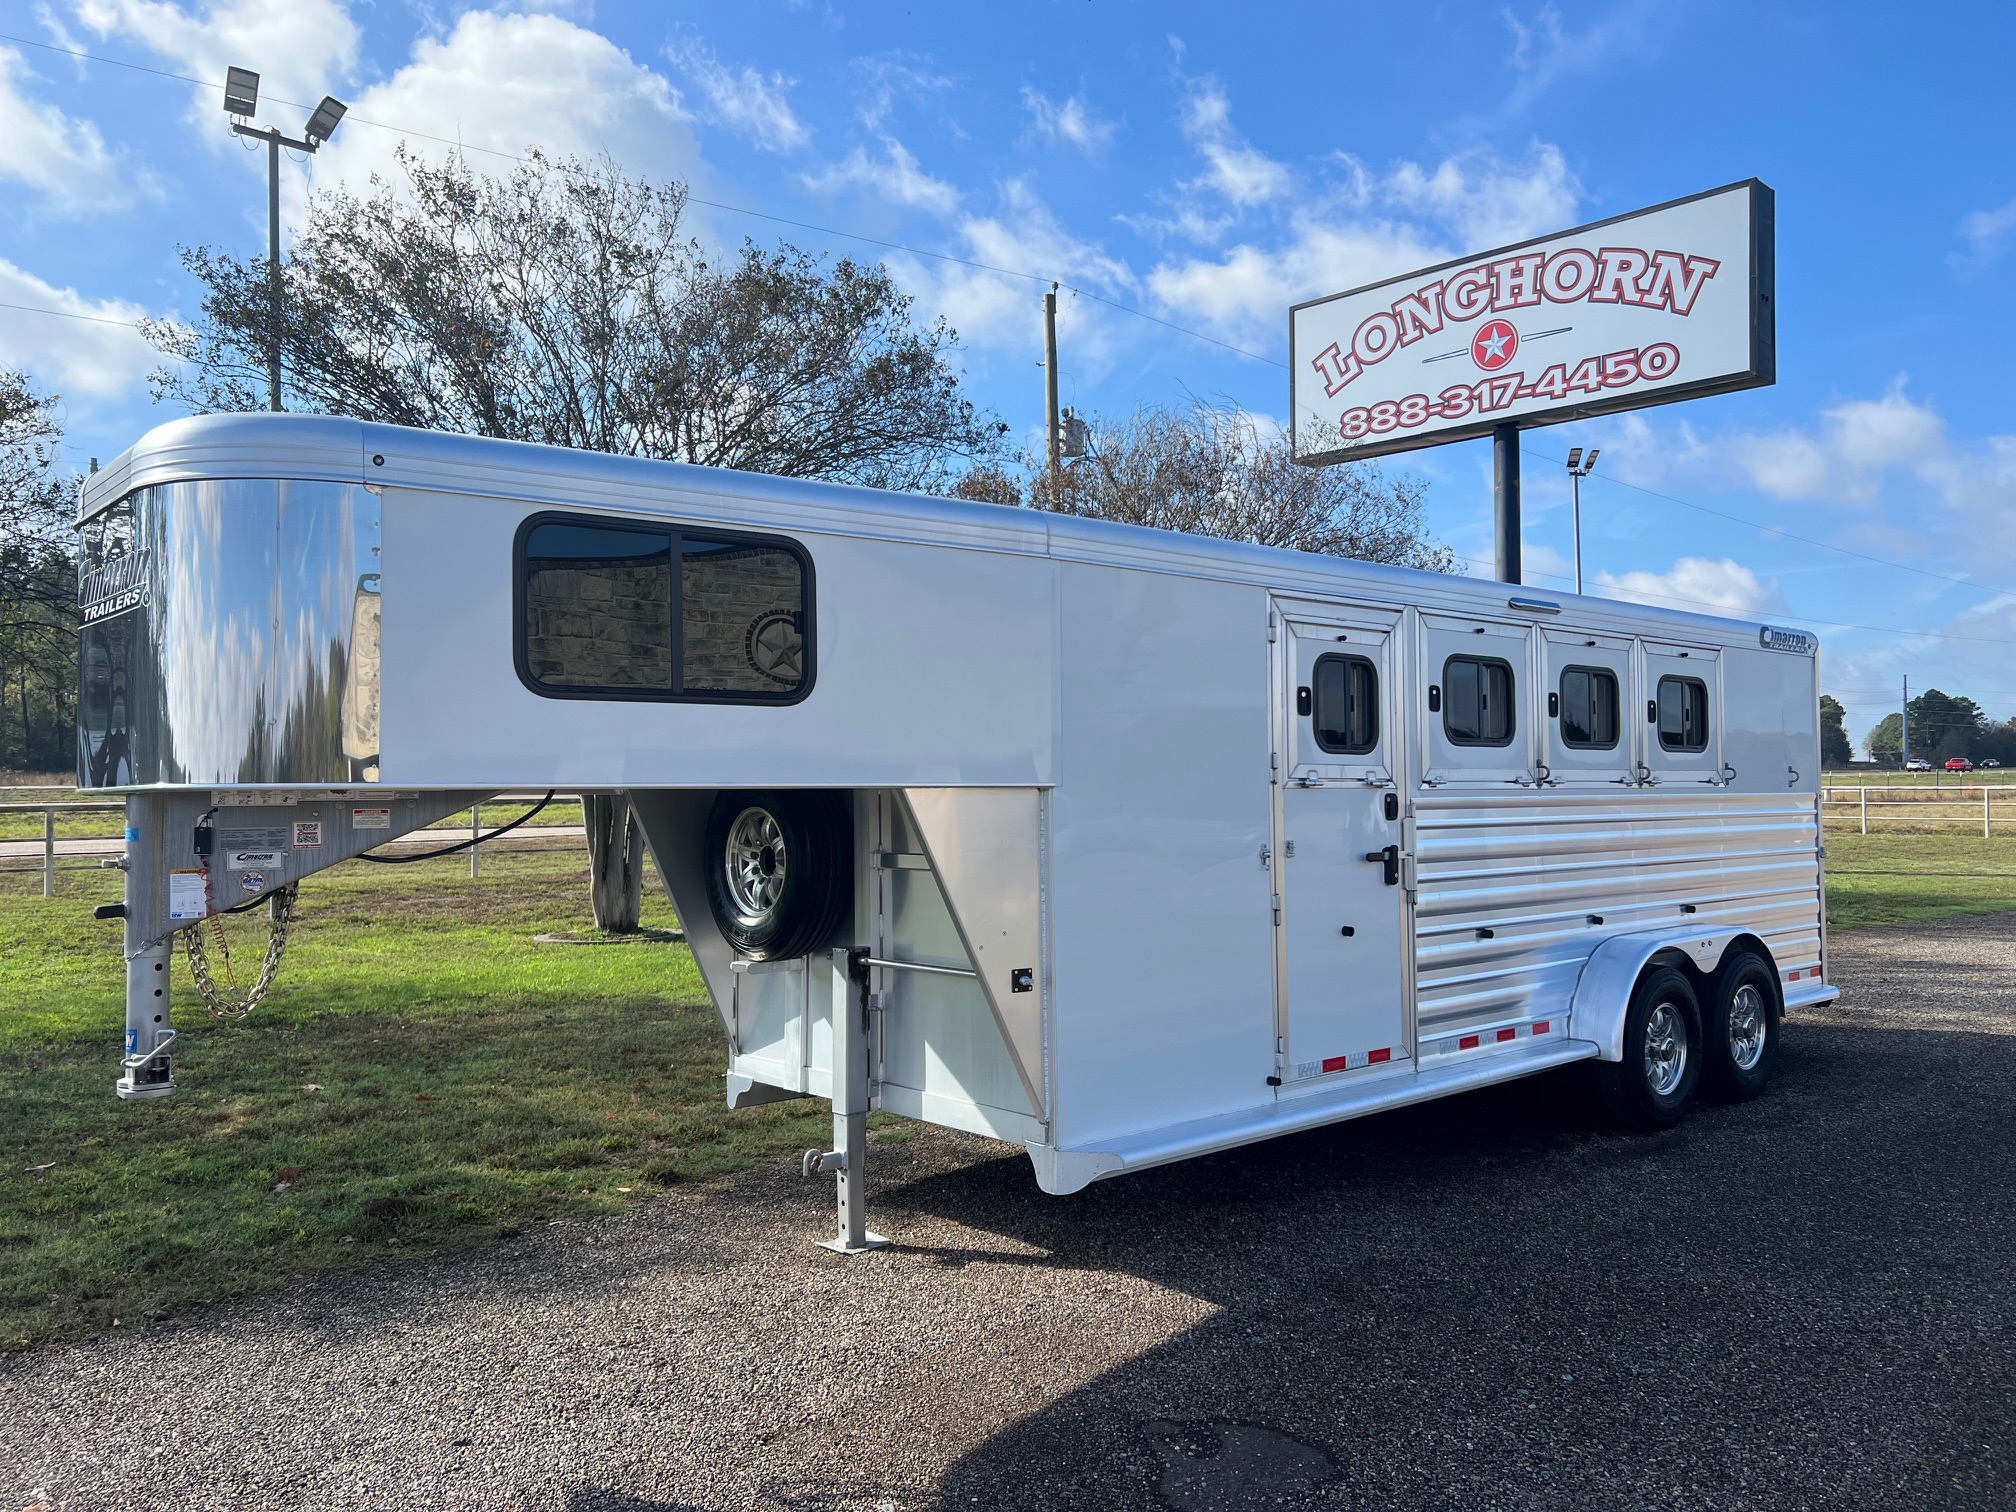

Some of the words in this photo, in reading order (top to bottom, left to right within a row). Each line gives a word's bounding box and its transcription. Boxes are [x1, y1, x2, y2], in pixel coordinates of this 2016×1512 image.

[1312, 247, 1721, 397] LONGHORN
[1340, 343, 1680, 440] 888-317-4450
[84, 589, 140, 622] TRAILERS
[1759, 626, 1807, 647] Cimarron
[1769, 642, 1805, 653] TRAILERS
